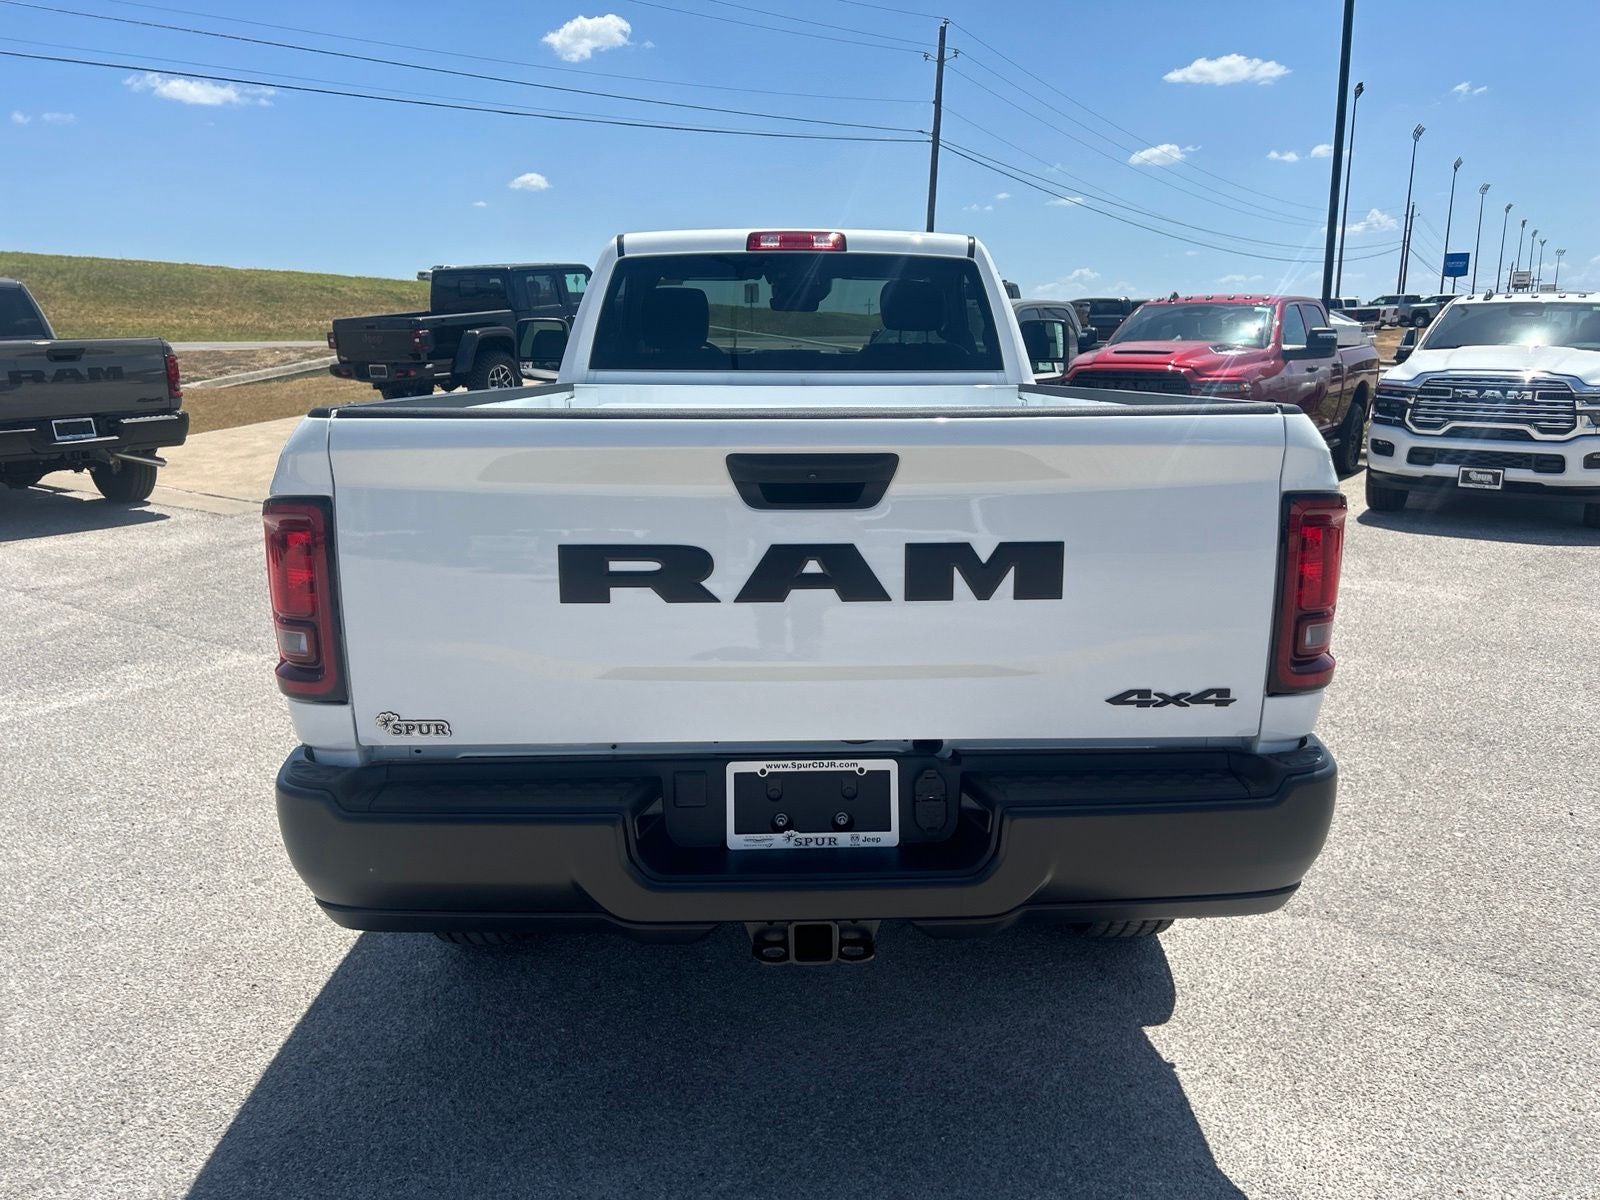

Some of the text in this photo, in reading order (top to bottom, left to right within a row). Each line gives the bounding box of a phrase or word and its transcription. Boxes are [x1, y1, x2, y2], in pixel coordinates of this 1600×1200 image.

[7, 366, 124, 385] RAM
[1455, 388, 1533, 400] RAM
[558, 541, 1064, 603] RAM
[1105, 688, 1237, 708] 4x4
[392, 723, 447, 735] SPUR
[765, 761, 859, 770] www.SpurCDJR.com
[794, 836, 838, 847] SPUR
[862, 836, 881, 844] Jeep
